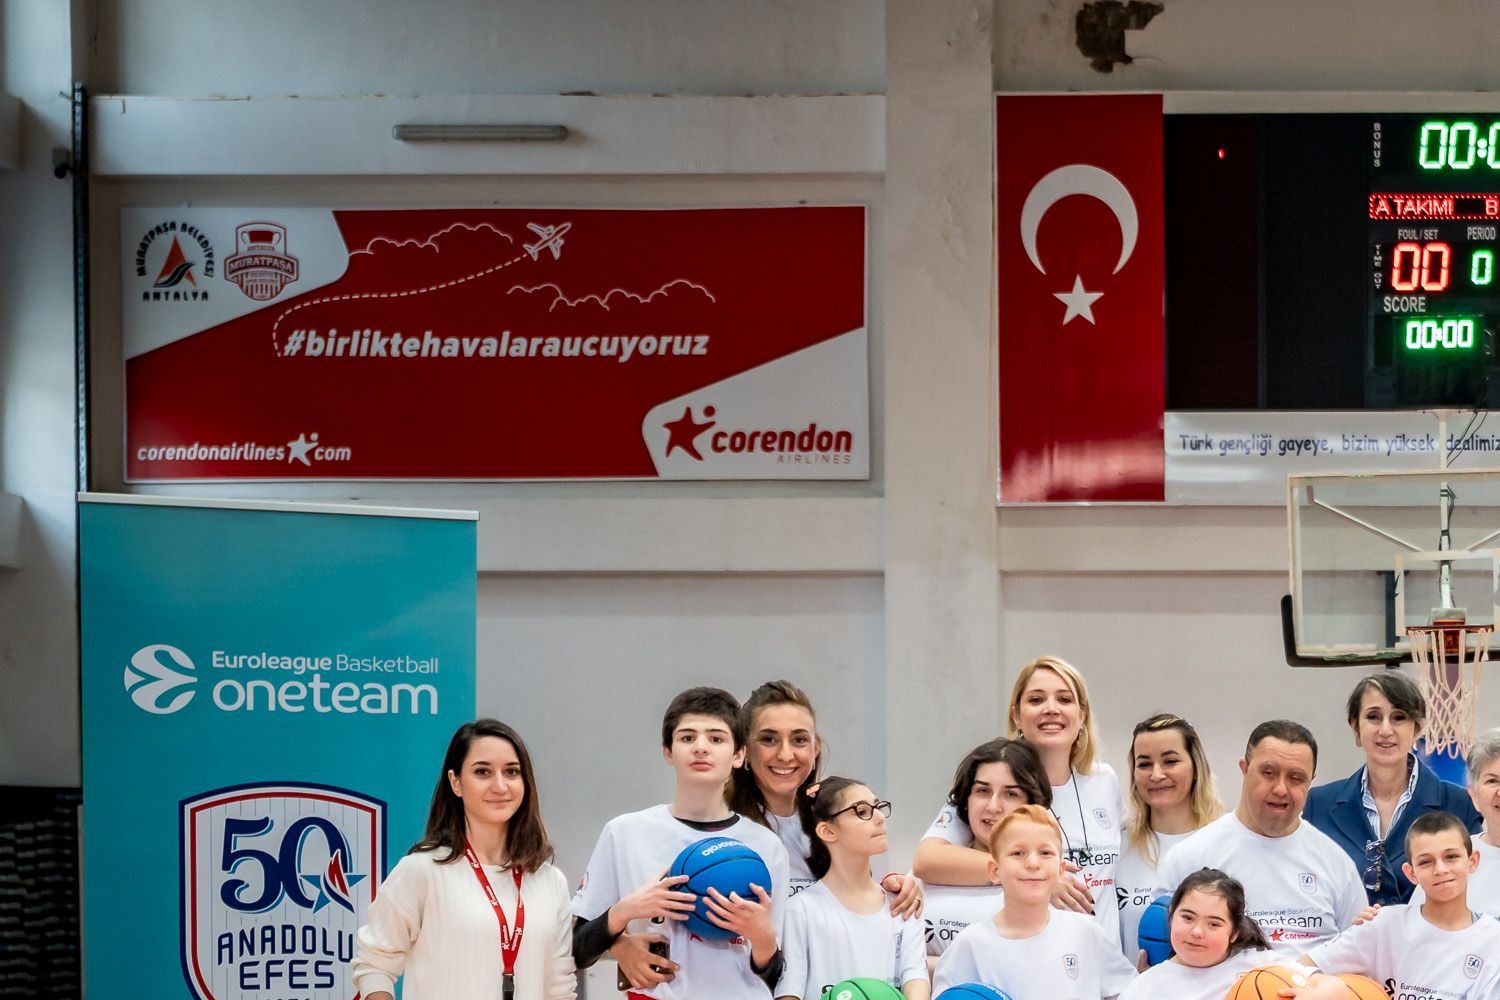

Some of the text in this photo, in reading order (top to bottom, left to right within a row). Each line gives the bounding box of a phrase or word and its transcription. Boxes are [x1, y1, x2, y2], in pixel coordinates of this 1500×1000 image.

[1373, 122, 1381, 168] BONUS
[1375, 199, 1391, 216] A
[1485, 199, 1499, 216] B
[1397, 229, 1421, 240] FOUL
[1424, 229, 1439, 240] SET
[1467, 227, 1496, 241] PERIOD
[136, 221, 215, 279] MURATPAŞA BELEDİYESİ
[229, 256, 294, 274] MURATPAŞA
[1374, 244, 1383, 289] TIME OUT
[1391, 243, 1451, 291] 00
[1470, 250, 1493, 285] 0
[142, 291, 209, 301] ANTALYA
[1383, 296, 1426, 313] SCORE
[284, 329, 710, 363] #birliktehavalaraucuyoruz
[1405, 319, 1474, 350] 00:00
[136, 440, 352, 461] corendonairlines com
[710, 422, 853, 454] corendon
[1179, 434, 1214, 451] Türk
[1219, 433, 1273, 456] gençliği
[1278, 438, 1334, 456] gayeye,
[1341, 434, 1379, 451] bizim
[1386, 434, 1435, 456] yüksek
[775, 454, 852, 465] AIRLINES
[212, 650, 439, 675] Euroleague Basketball
[212, 673, 439, 715] oneteam
[220, 816, 354, 915] 50
[217, 924, 354, 966] ANADOLU
[239, 959, 335, 990] EFES
